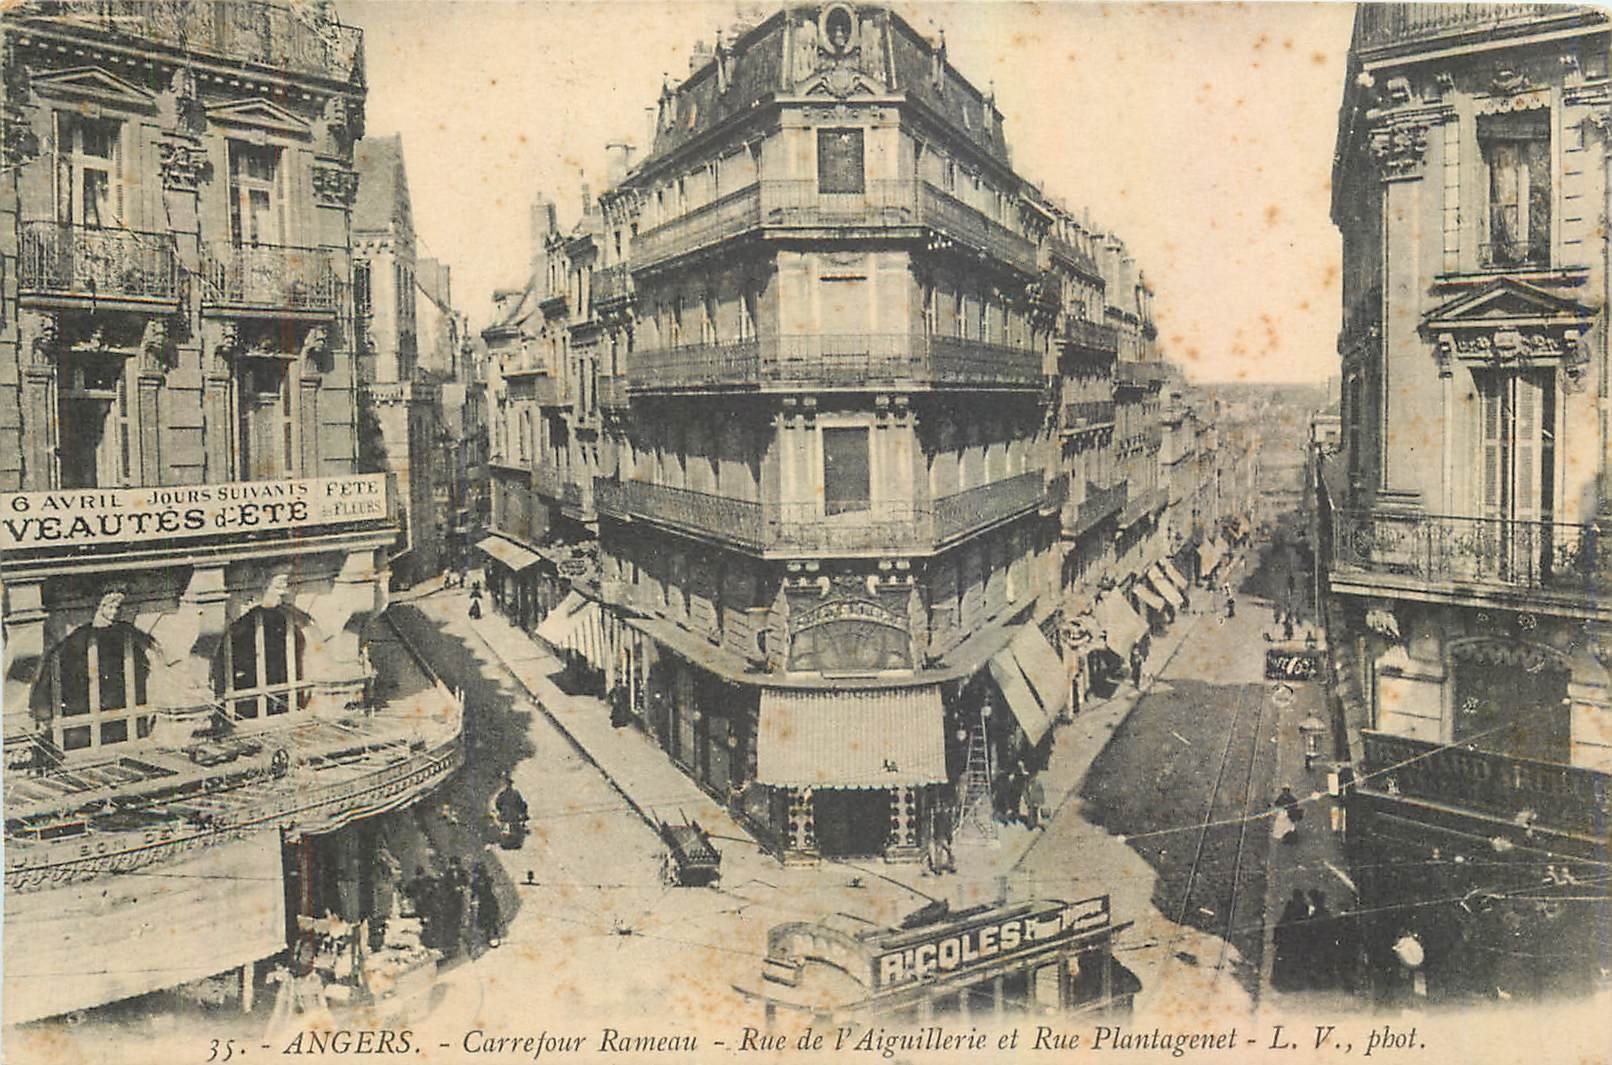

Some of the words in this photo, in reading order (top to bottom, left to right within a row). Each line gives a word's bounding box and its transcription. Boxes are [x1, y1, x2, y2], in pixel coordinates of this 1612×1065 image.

[41, 494, 124, 511] AVRIL
[147, 490, 212, 505] JOURS
[217, 483, 309, 501] SUIVANTS
